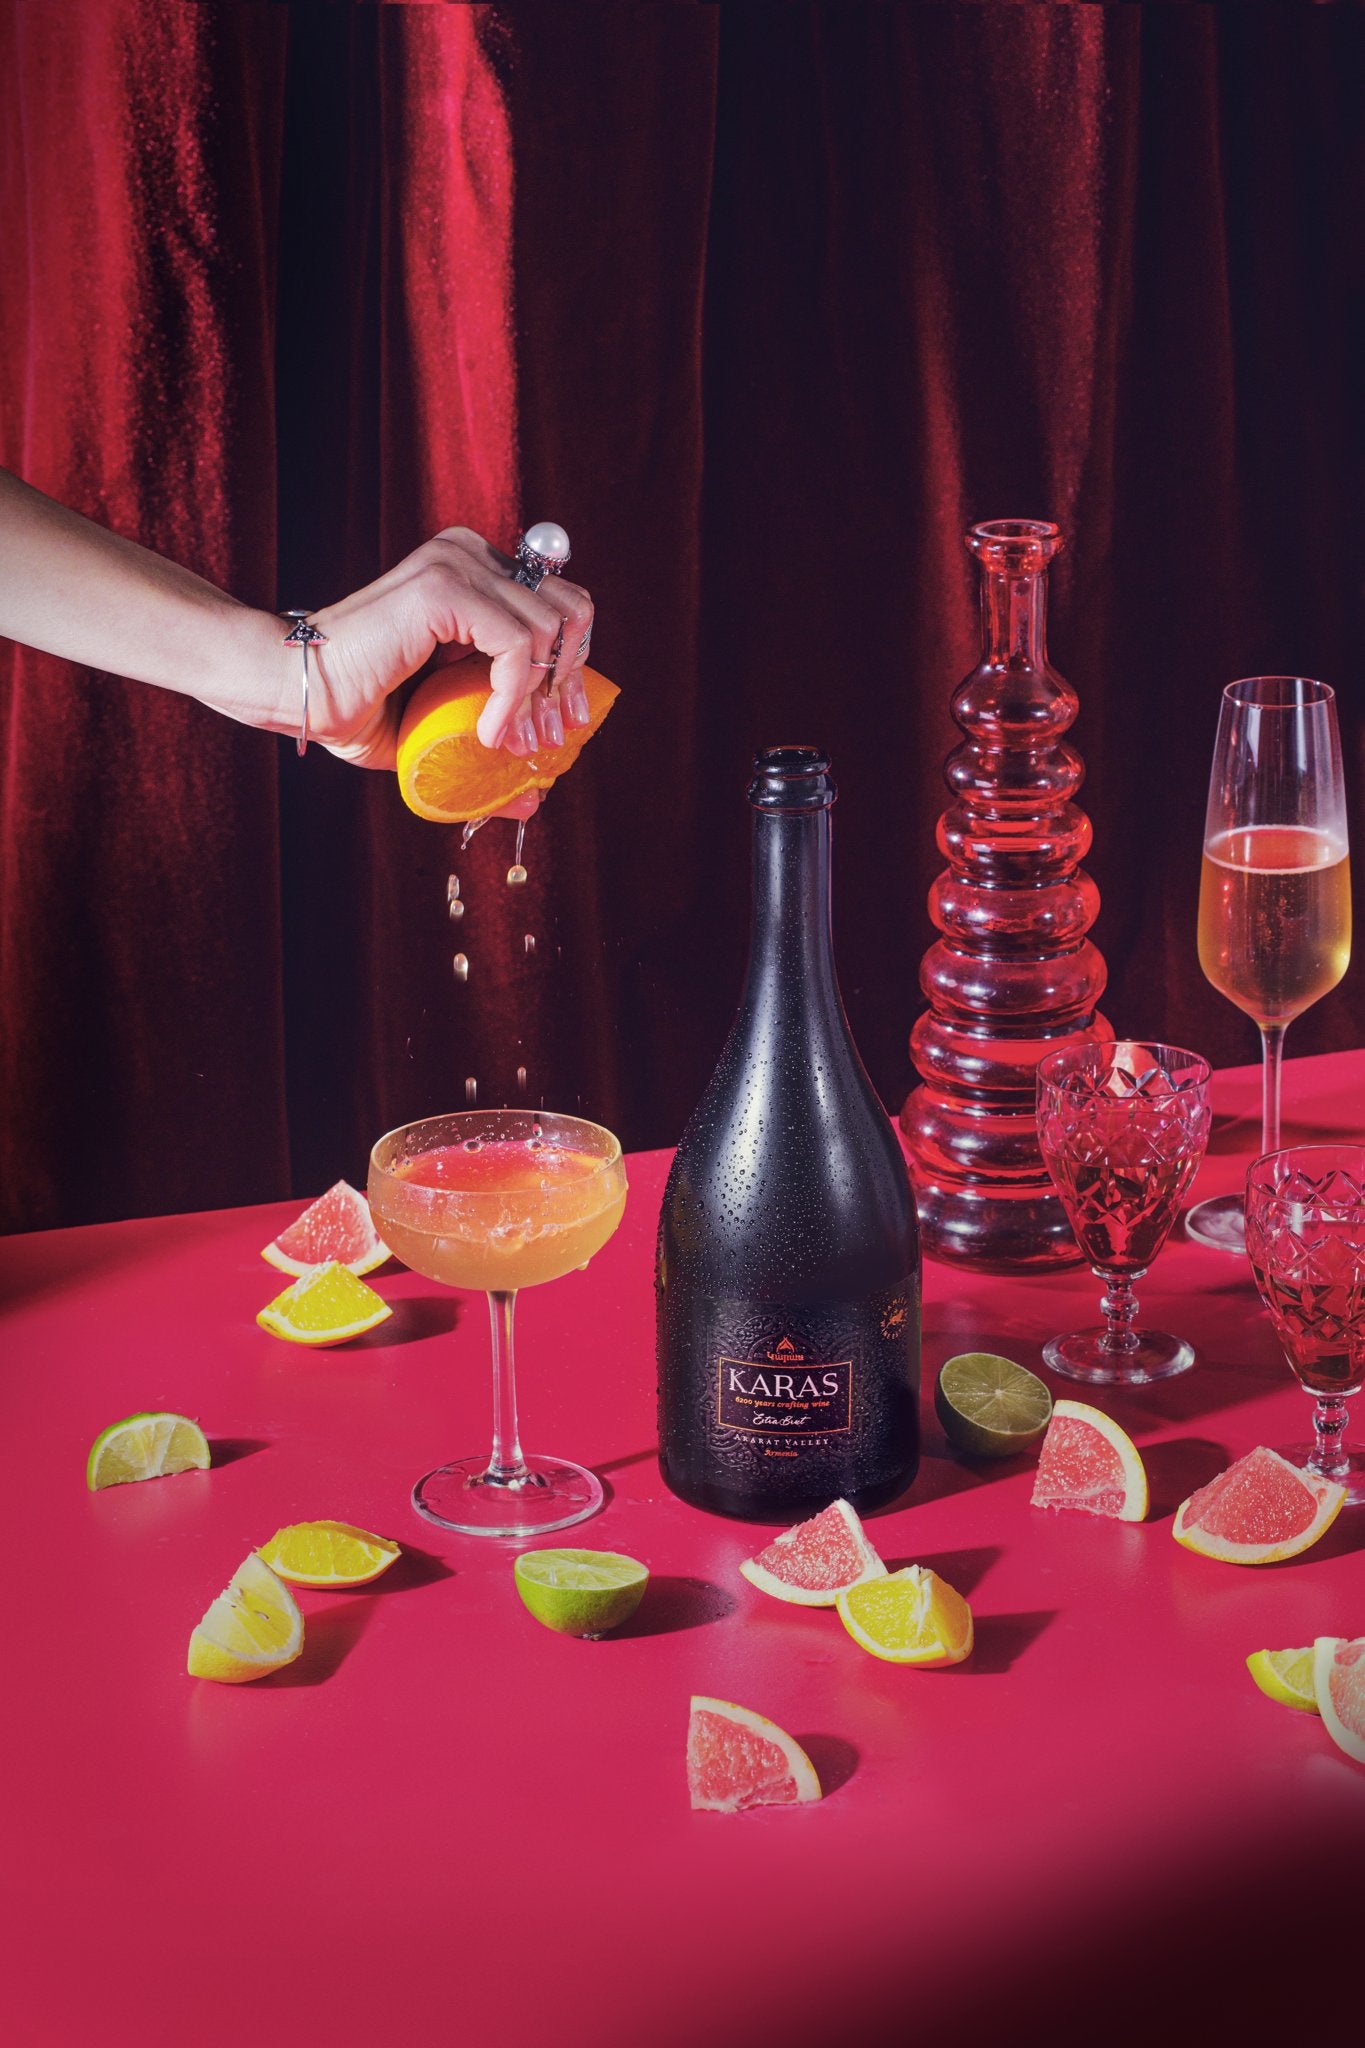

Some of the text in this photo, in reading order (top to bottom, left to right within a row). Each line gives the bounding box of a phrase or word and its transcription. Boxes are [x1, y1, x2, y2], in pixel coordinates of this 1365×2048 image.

[729, 1368, 838, 1400] KARAS
[735, 1396, 830, 1410] 6200 years crafting wine
[734, 1433, 779, 1446] ARARAT
[764, 1449, 799, 1457] Armenia
